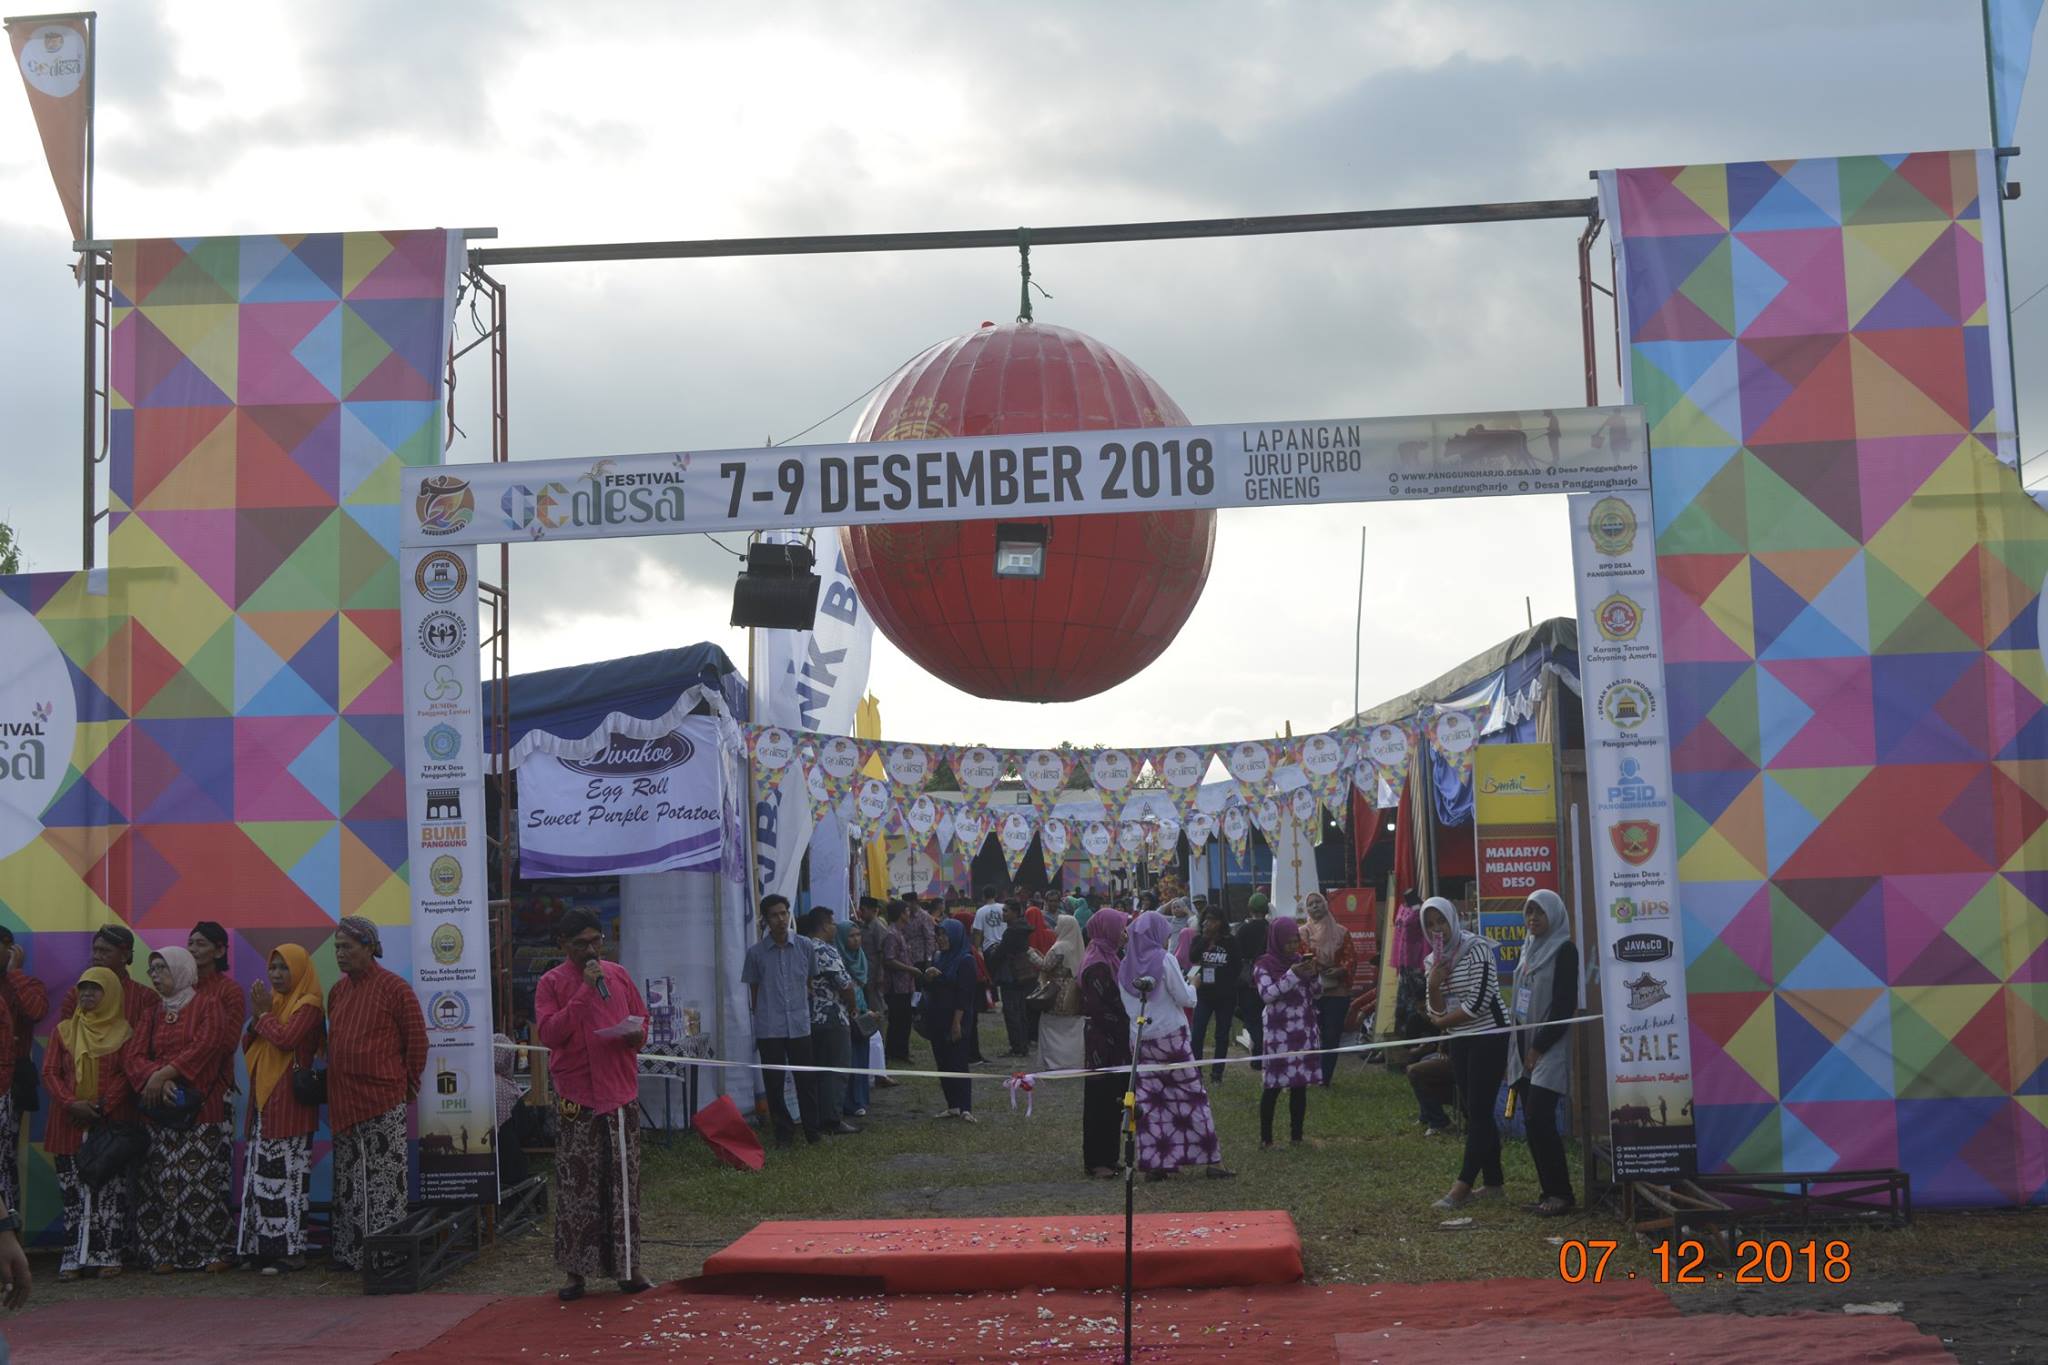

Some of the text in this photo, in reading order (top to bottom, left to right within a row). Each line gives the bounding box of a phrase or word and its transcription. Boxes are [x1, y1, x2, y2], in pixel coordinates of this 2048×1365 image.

[1243, 425, 1361, 453] LAPANGAN
[1244, 450, 1361, 477] JURU PURBO
[605, 471, 684, 487] FESTIVAL
[720, 438, 1215, 518] 7-9 DESEMBER 2018
[1534, 477, 1638, 490] Desa Panggungharjo
[1245, 475, 1320, 500] GENENG
[586, 777, 668, 803] Egg Roll
[1608, 786, 1656, 802] PSID
[528, 809, 581, 828] Sweet
[588, 805, 649, 827] Purple
[421, 826, 467, 841] BUMI
[421, 839, 468, 848] PANGGUNG
[1486, 847, 1550, 858] MAKARYO
[1486, 861, 1551, 873] MBANGUN
[1502, 876, 1535, 888] DESO
[1638, 899, 1670, 916] JPS
[1486, 926, 1526, 940] KECAM
[1619, 1033, 1681, 1063] SALE
[441, 1098, 467, 1110] IPHI
